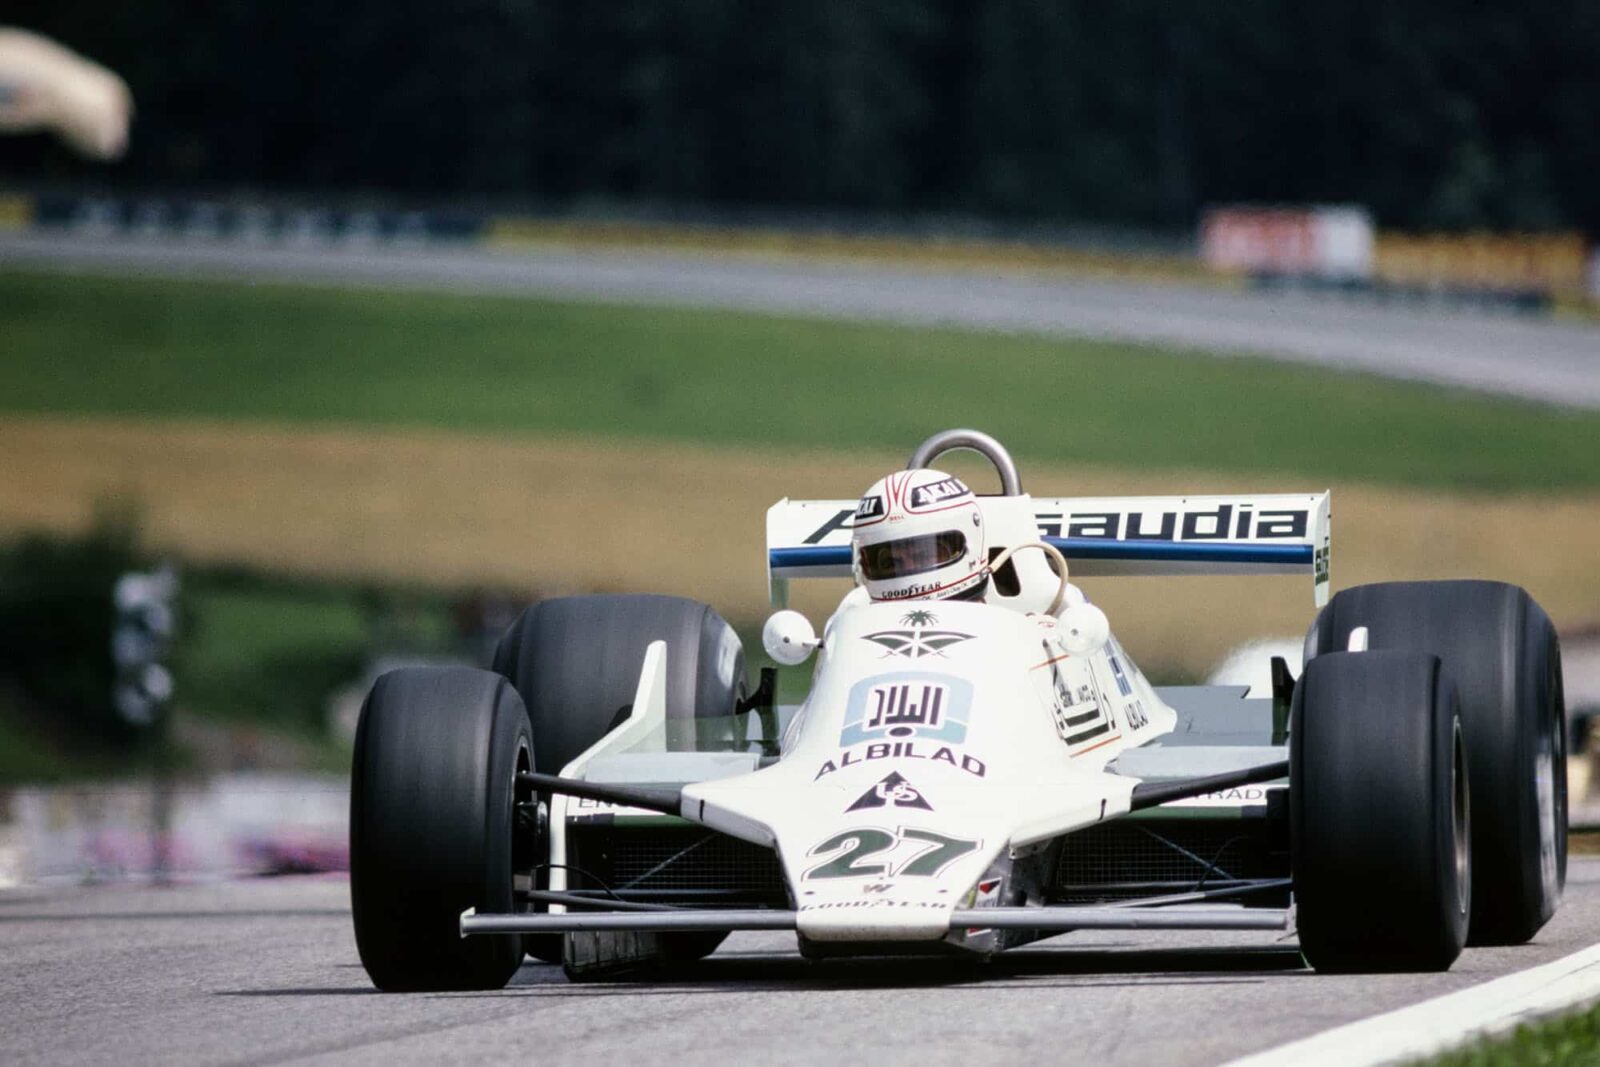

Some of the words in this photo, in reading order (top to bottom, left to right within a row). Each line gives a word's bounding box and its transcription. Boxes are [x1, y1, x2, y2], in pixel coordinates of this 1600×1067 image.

[1034, 505, 1308, 540] saudia
[881, 581, 942, 600] GOODYEAR
[813, 742, 987, 783] ALBILAD
[802, 826, 983, 880] 27
